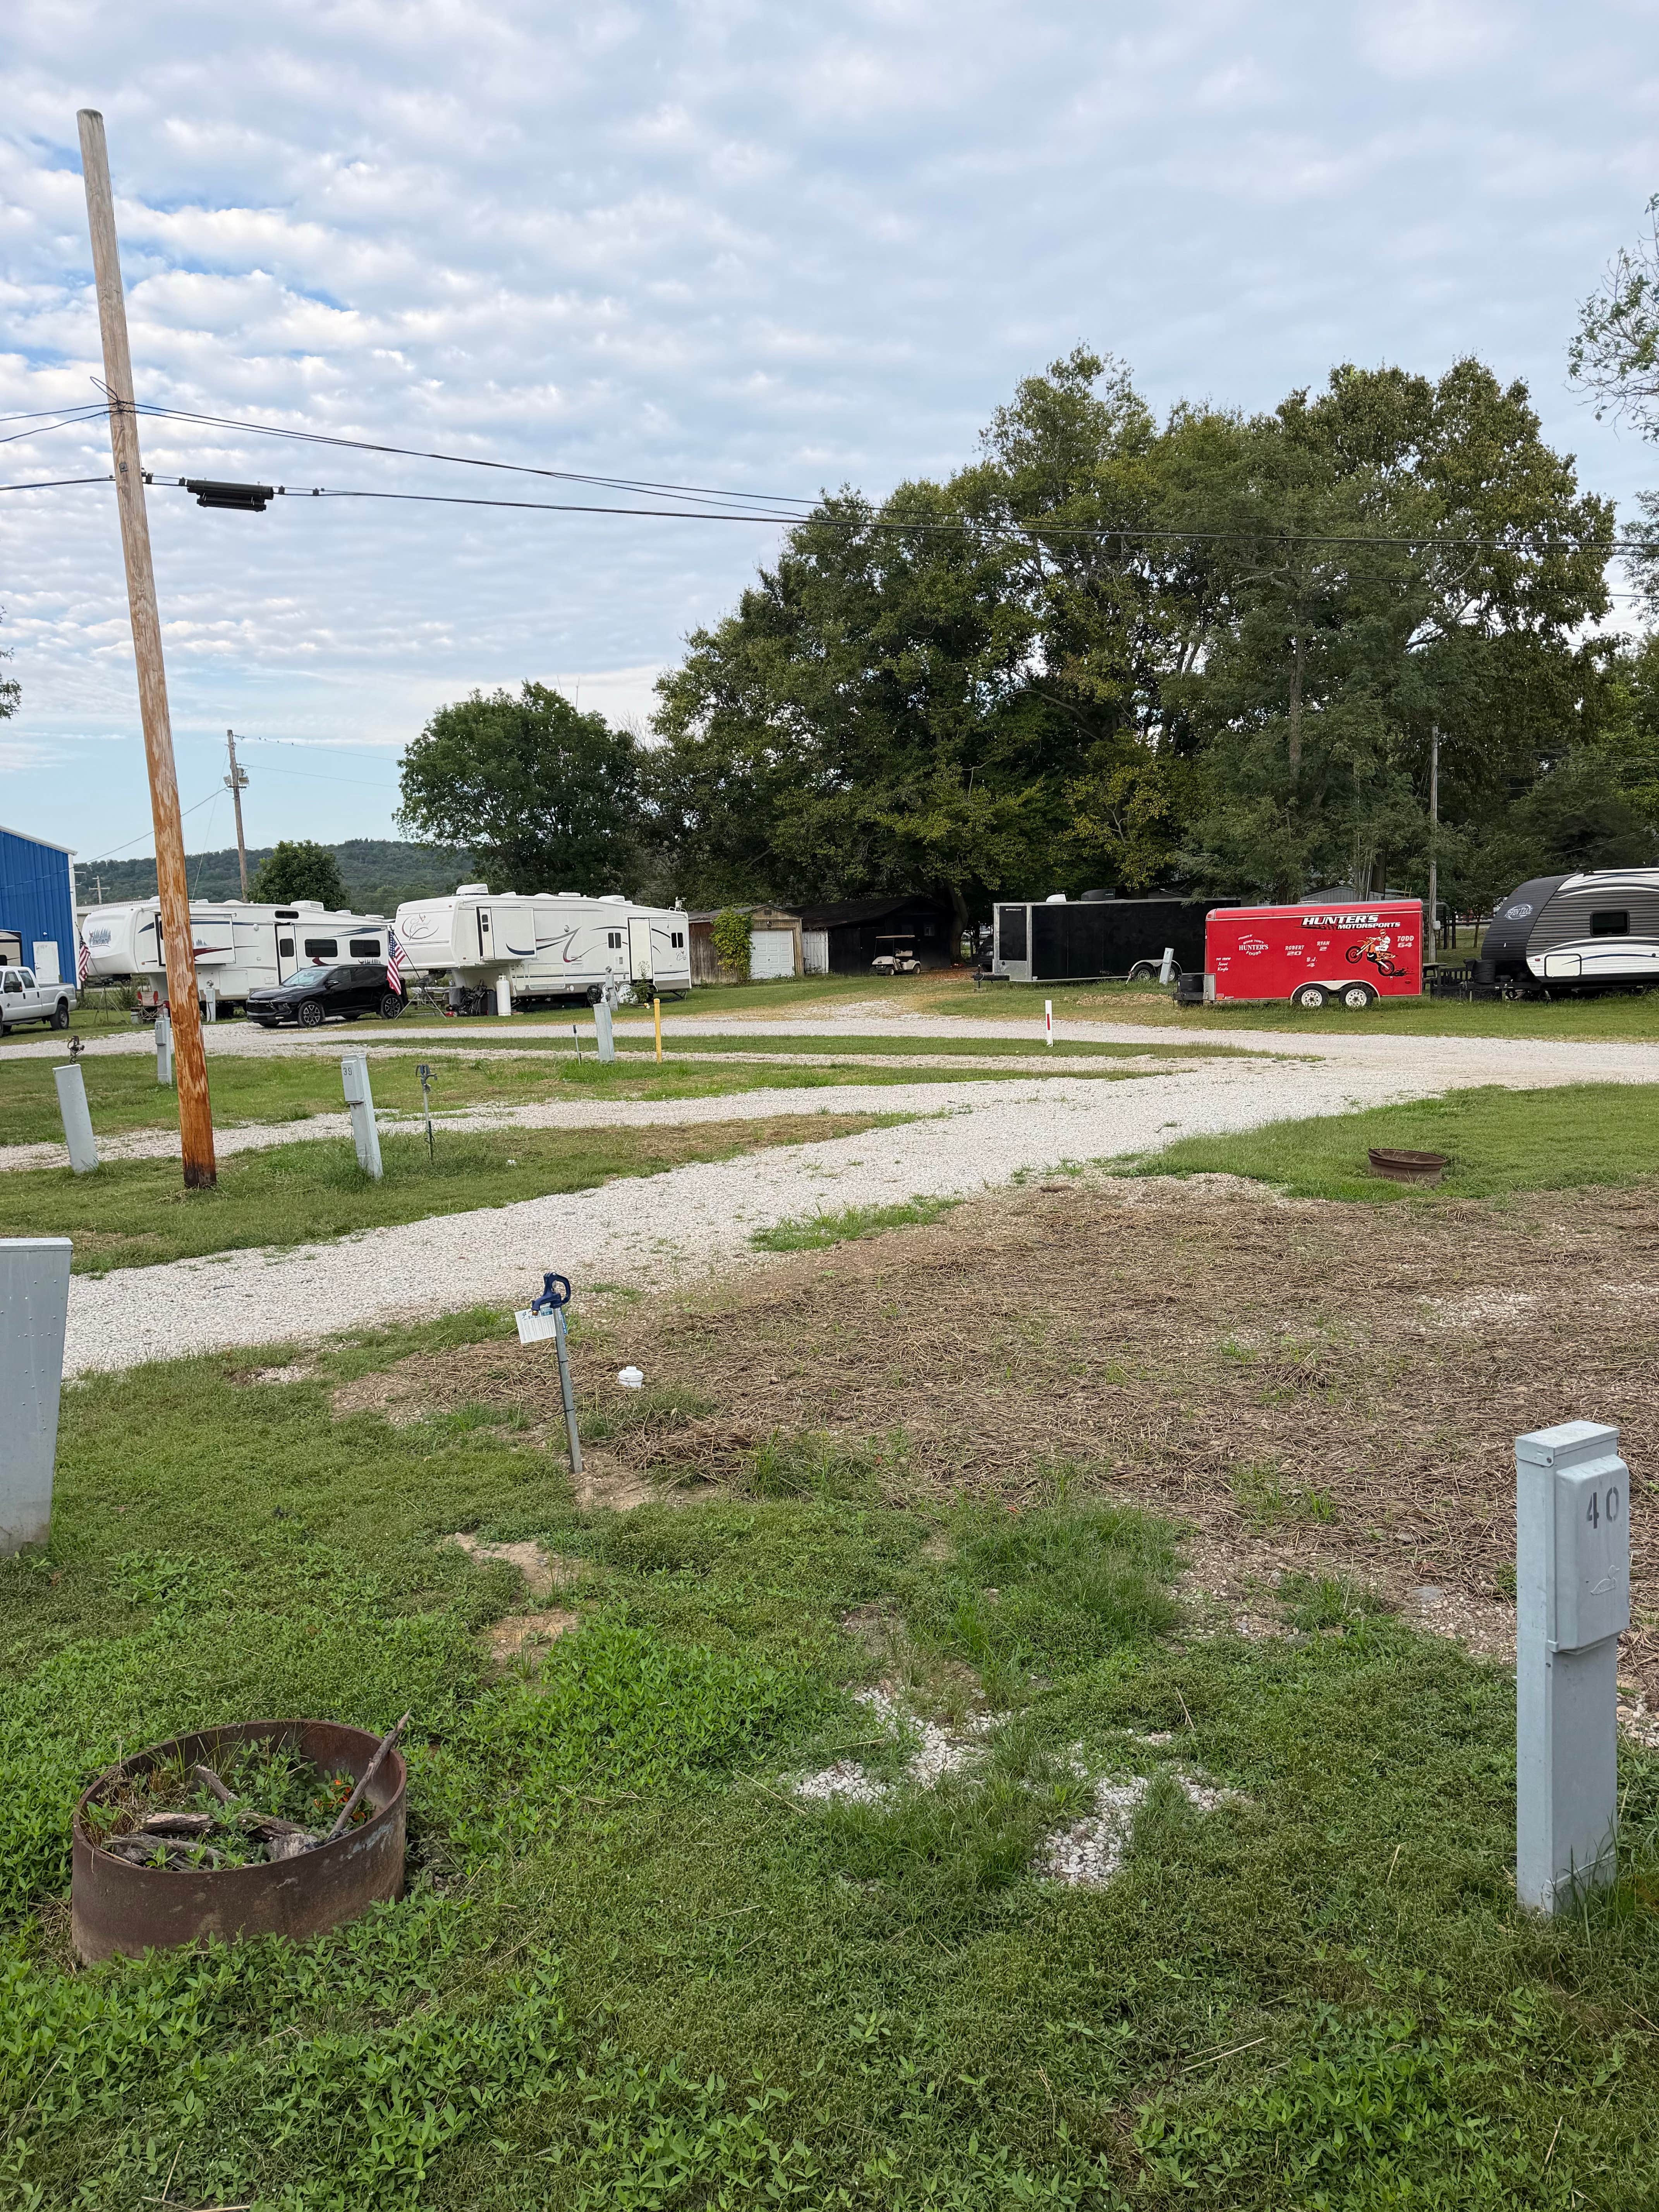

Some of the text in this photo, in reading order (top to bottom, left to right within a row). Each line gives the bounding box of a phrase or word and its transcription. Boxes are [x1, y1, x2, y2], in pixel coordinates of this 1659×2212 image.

[1302, 915, 1379, 925] HUNTER'S
[343, 1067, 352, 1075] 39
[1586, 1487, 1620, 1529] 40
